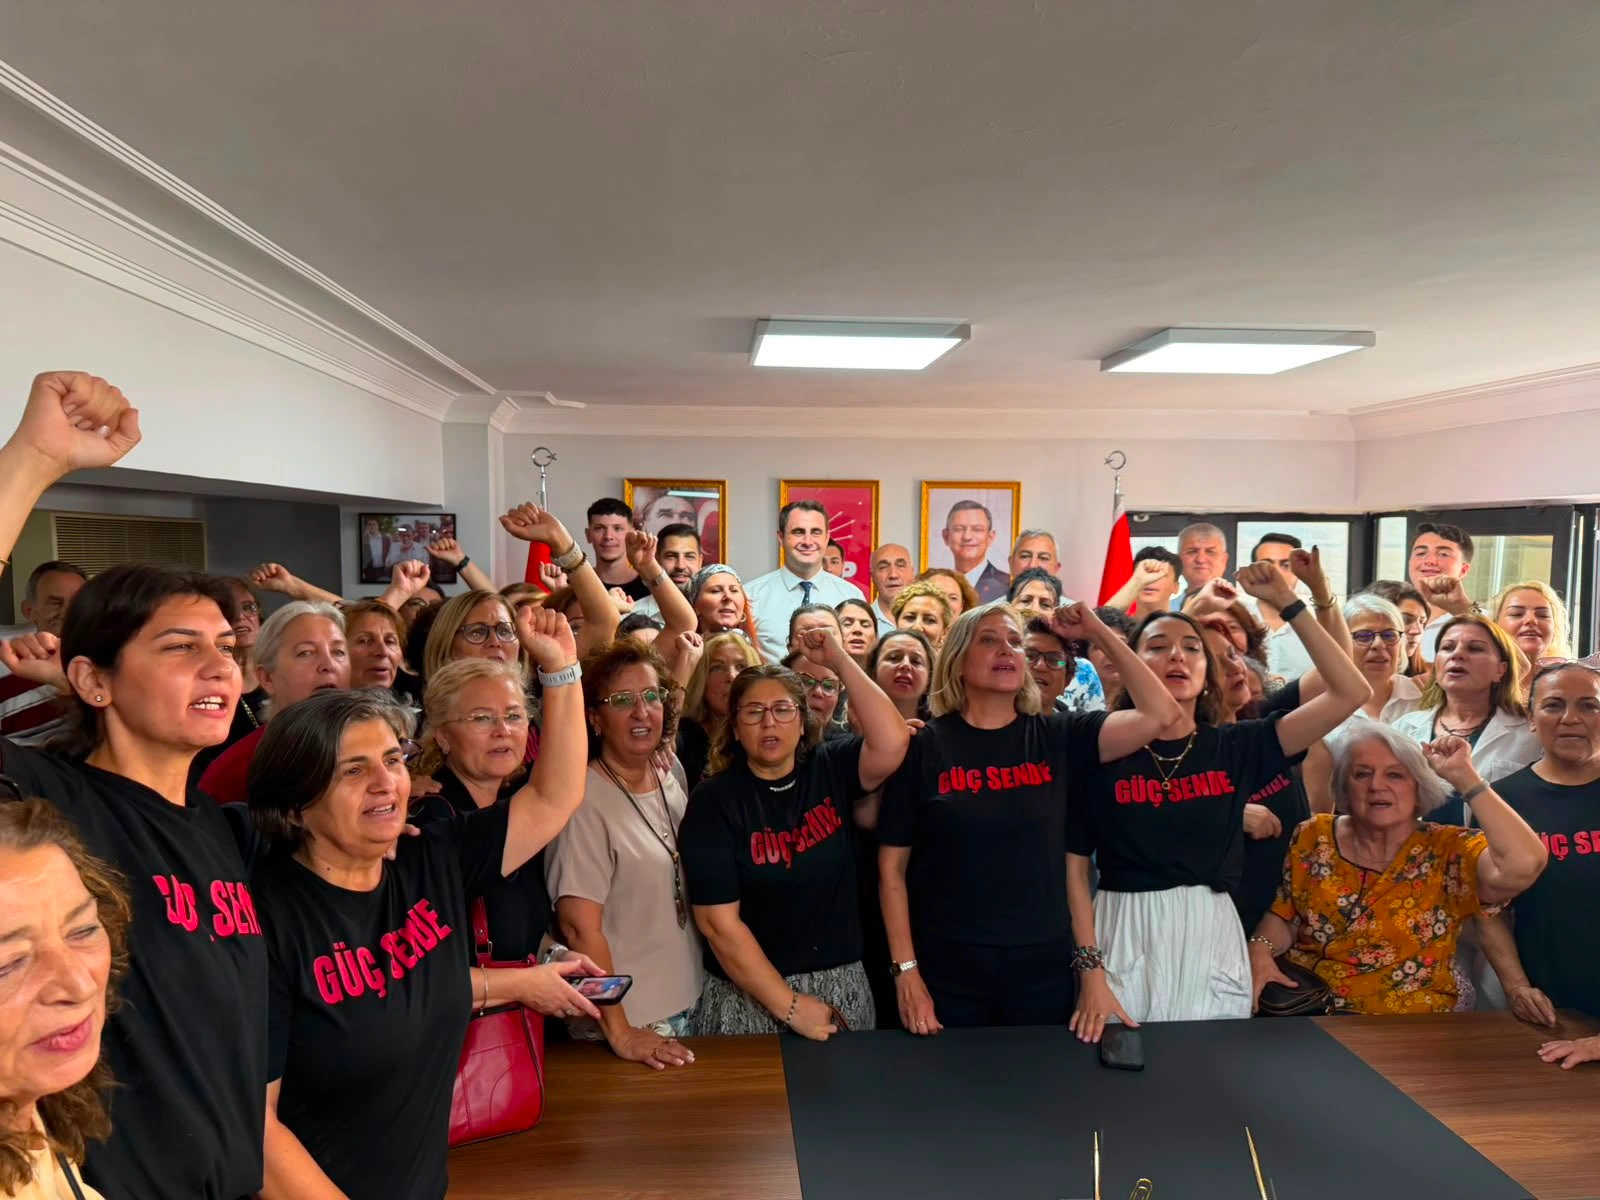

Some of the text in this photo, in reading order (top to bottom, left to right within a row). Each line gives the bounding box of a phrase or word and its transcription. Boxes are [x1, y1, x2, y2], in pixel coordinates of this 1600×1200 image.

[938, 761, 1053, 794] GÜÇ SENDE
[1115, 771, 1235, 807] GÜÇ SENDE
[751, 825, 792, 869] GÜÇ
[313, 941, 387, 1005] GÜÇ
